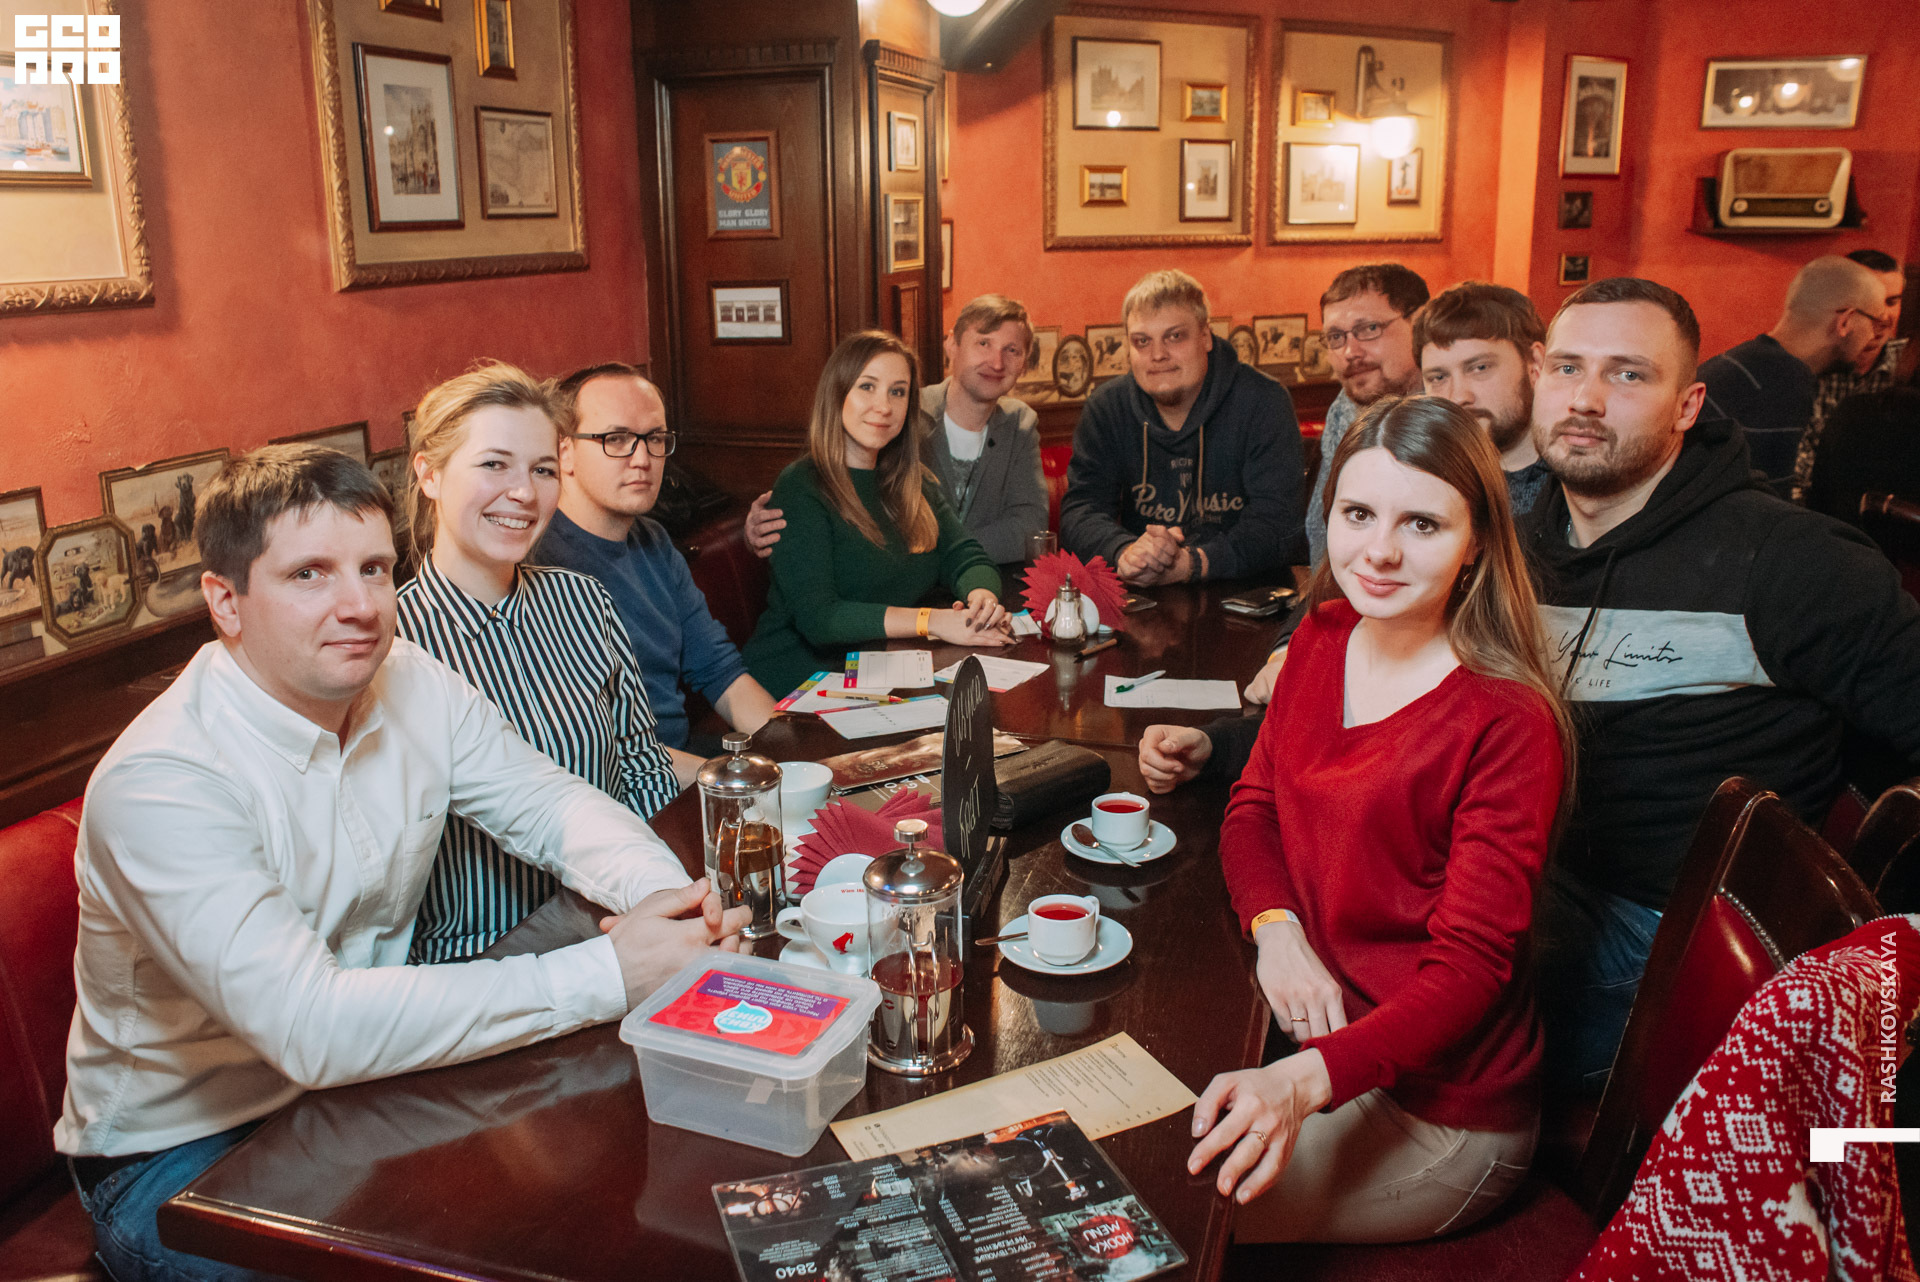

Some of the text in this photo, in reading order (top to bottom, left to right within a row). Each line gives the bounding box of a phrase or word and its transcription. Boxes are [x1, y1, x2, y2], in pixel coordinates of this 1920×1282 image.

[718, 208, 770, 218] GLORY GLORY
[718, 218, 768, 227] MAN UNITED
[1131, 483, 1176, 522] Pure
[1603, 632, 1683, 669] Limits
[1588, 678, 1612, 688] LIFE
[717, 1017, 761, 1031] КВИЗ
[1083, 1220, 1120, 1241] MENU
[1089, 1232, 1134, 1254] HOOKA
[776, 1262, 817, 1279] 2840
